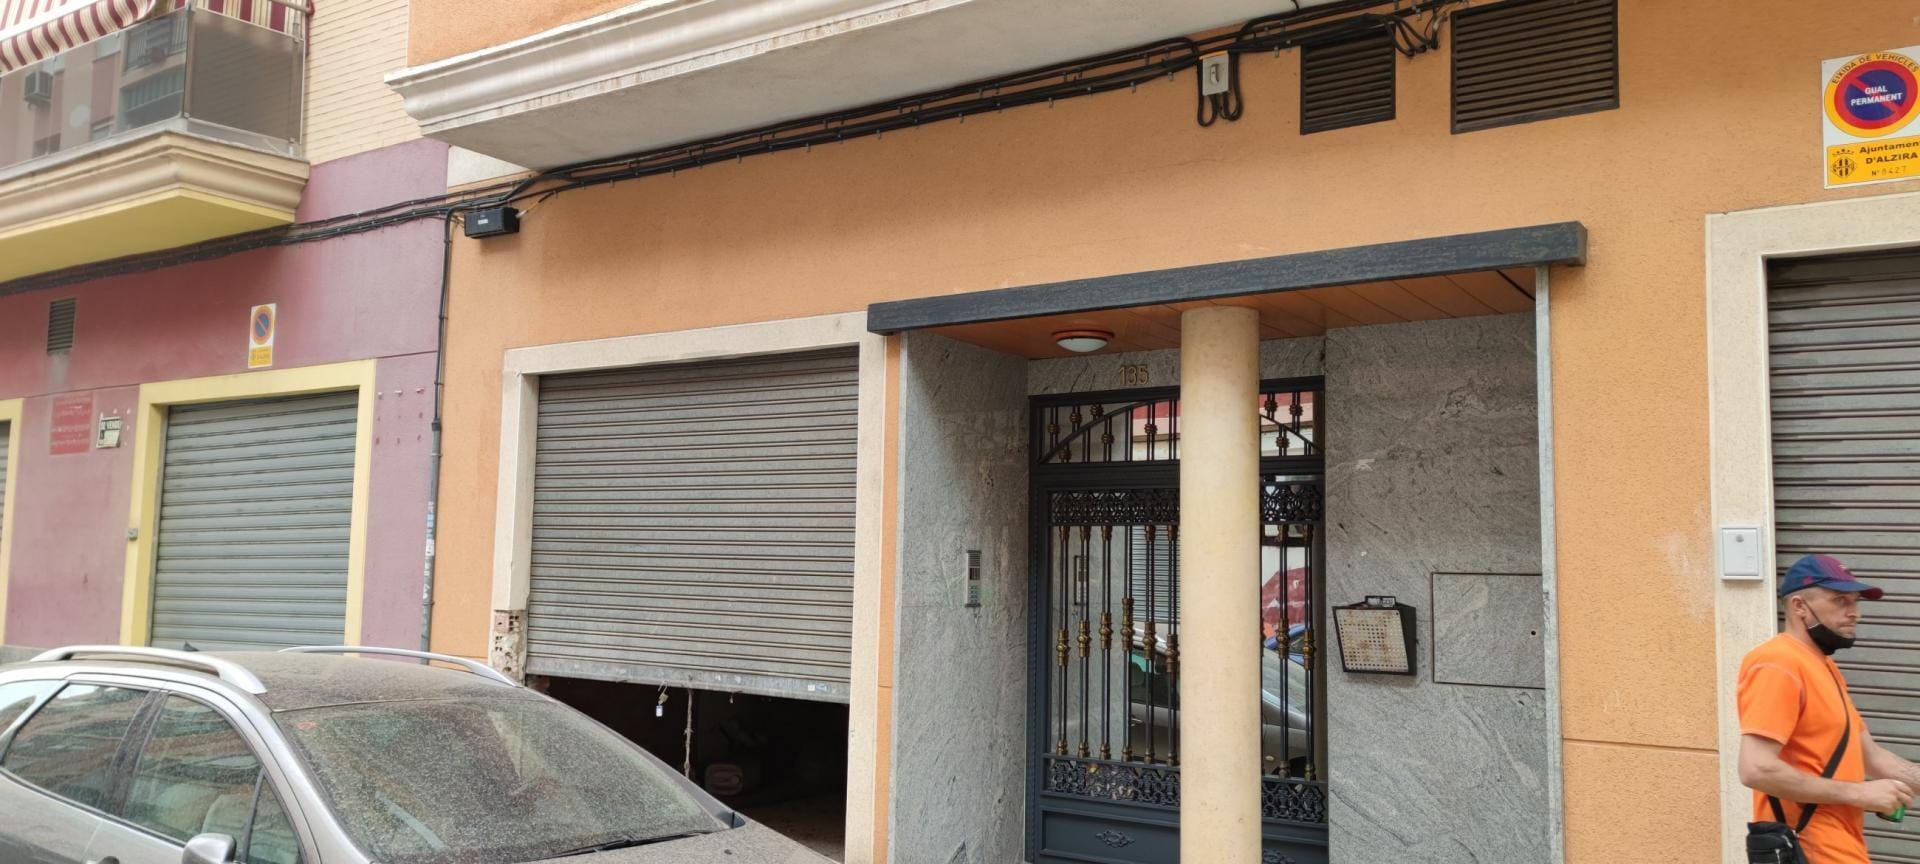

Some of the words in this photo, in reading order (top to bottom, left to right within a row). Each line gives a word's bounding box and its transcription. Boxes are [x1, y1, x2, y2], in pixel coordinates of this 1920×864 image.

[1832, 63, 1856, 84] EIXIDA
[1859, 55, 1872, 63] DE
[1875, 53, 1919, 72] VEHICLES
[1864, 85, 1888, 95] GUAL
[1850, 92, 1903, 106] PERMANENT
[1859, 141, 1920, 154] Ajuntamen
[1865, 152, 1918, 164] D'ALZIRA
[1119, 364, 1149, 385] 135
